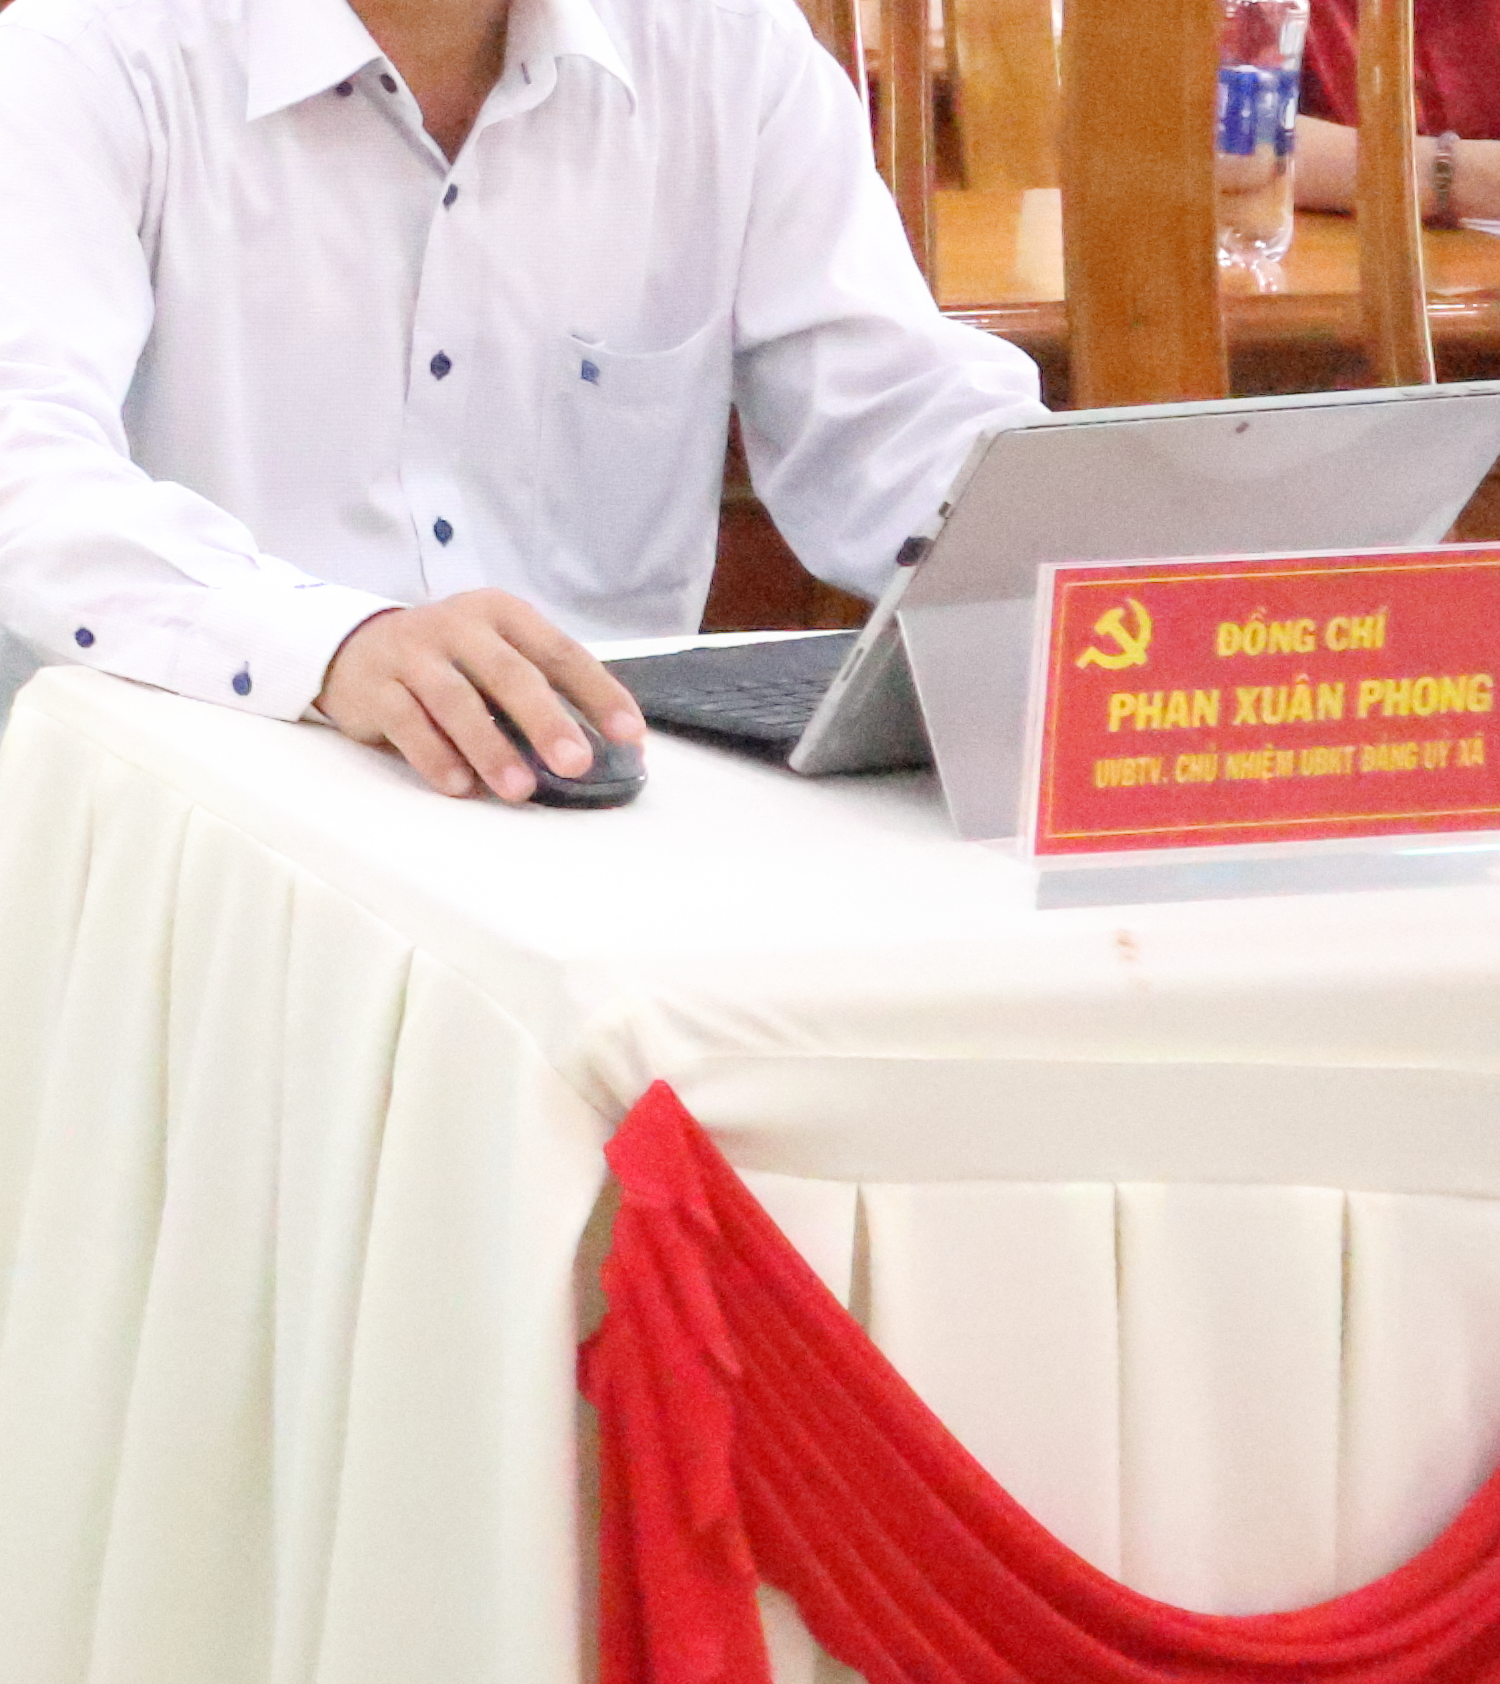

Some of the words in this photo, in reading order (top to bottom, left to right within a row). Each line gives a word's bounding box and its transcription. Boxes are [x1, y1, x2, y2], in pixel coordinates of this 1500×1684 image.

[1216, 607, 1317, 657] ĐỒNG
[1325, 605, 1390, 651] CHÍ
[1107, 688, 1221, 733] PHAN
[1233, 673, 1346, 726] XUÂN
[1356, 673, 1494, 719] PHONG
[1225, 743, 1295, 783] NHIỆM
